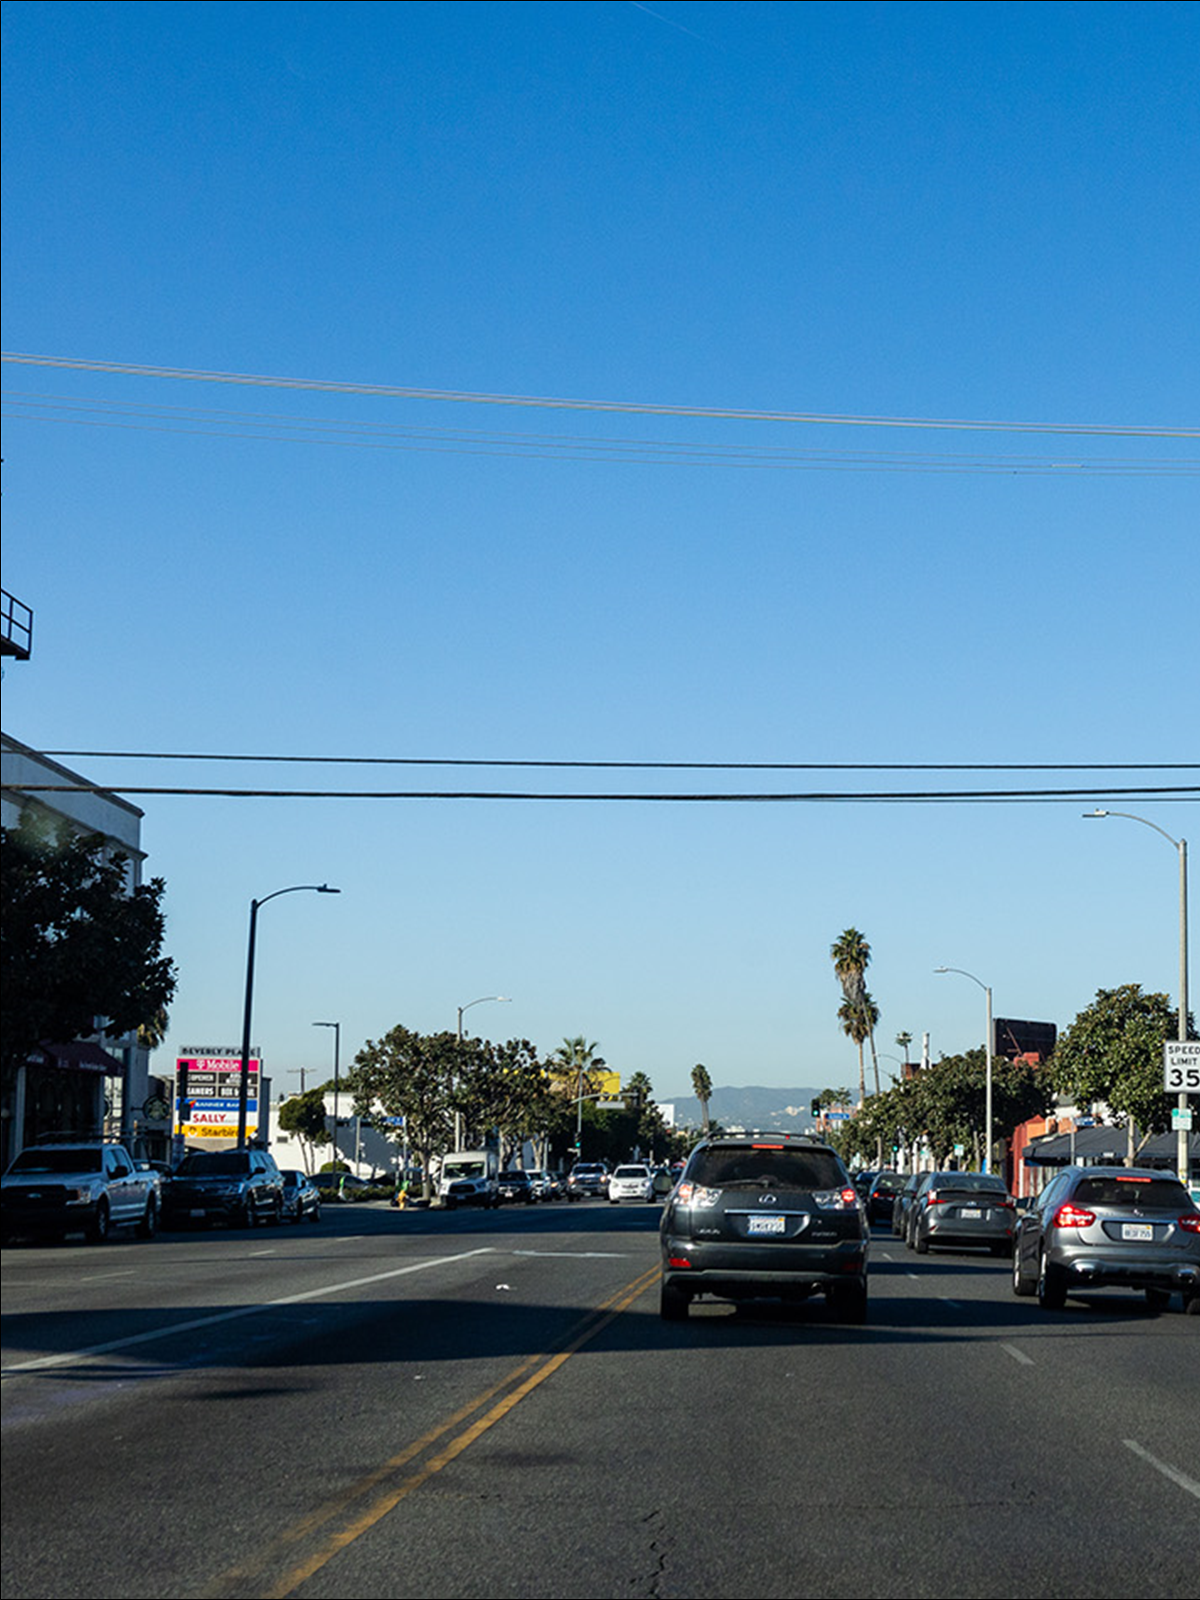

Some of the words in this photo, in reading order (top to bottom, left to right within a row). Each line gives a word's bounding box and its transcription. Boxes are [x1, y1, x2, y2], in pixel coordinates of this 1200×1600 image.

[1168, 1046, 1200, 1055] SPEED
[1171, 1058, 1197, 1066] LIMIT
[1170, 1069, 1200, 1087] 35
[193, 1113, 227, 1123] SALLY
